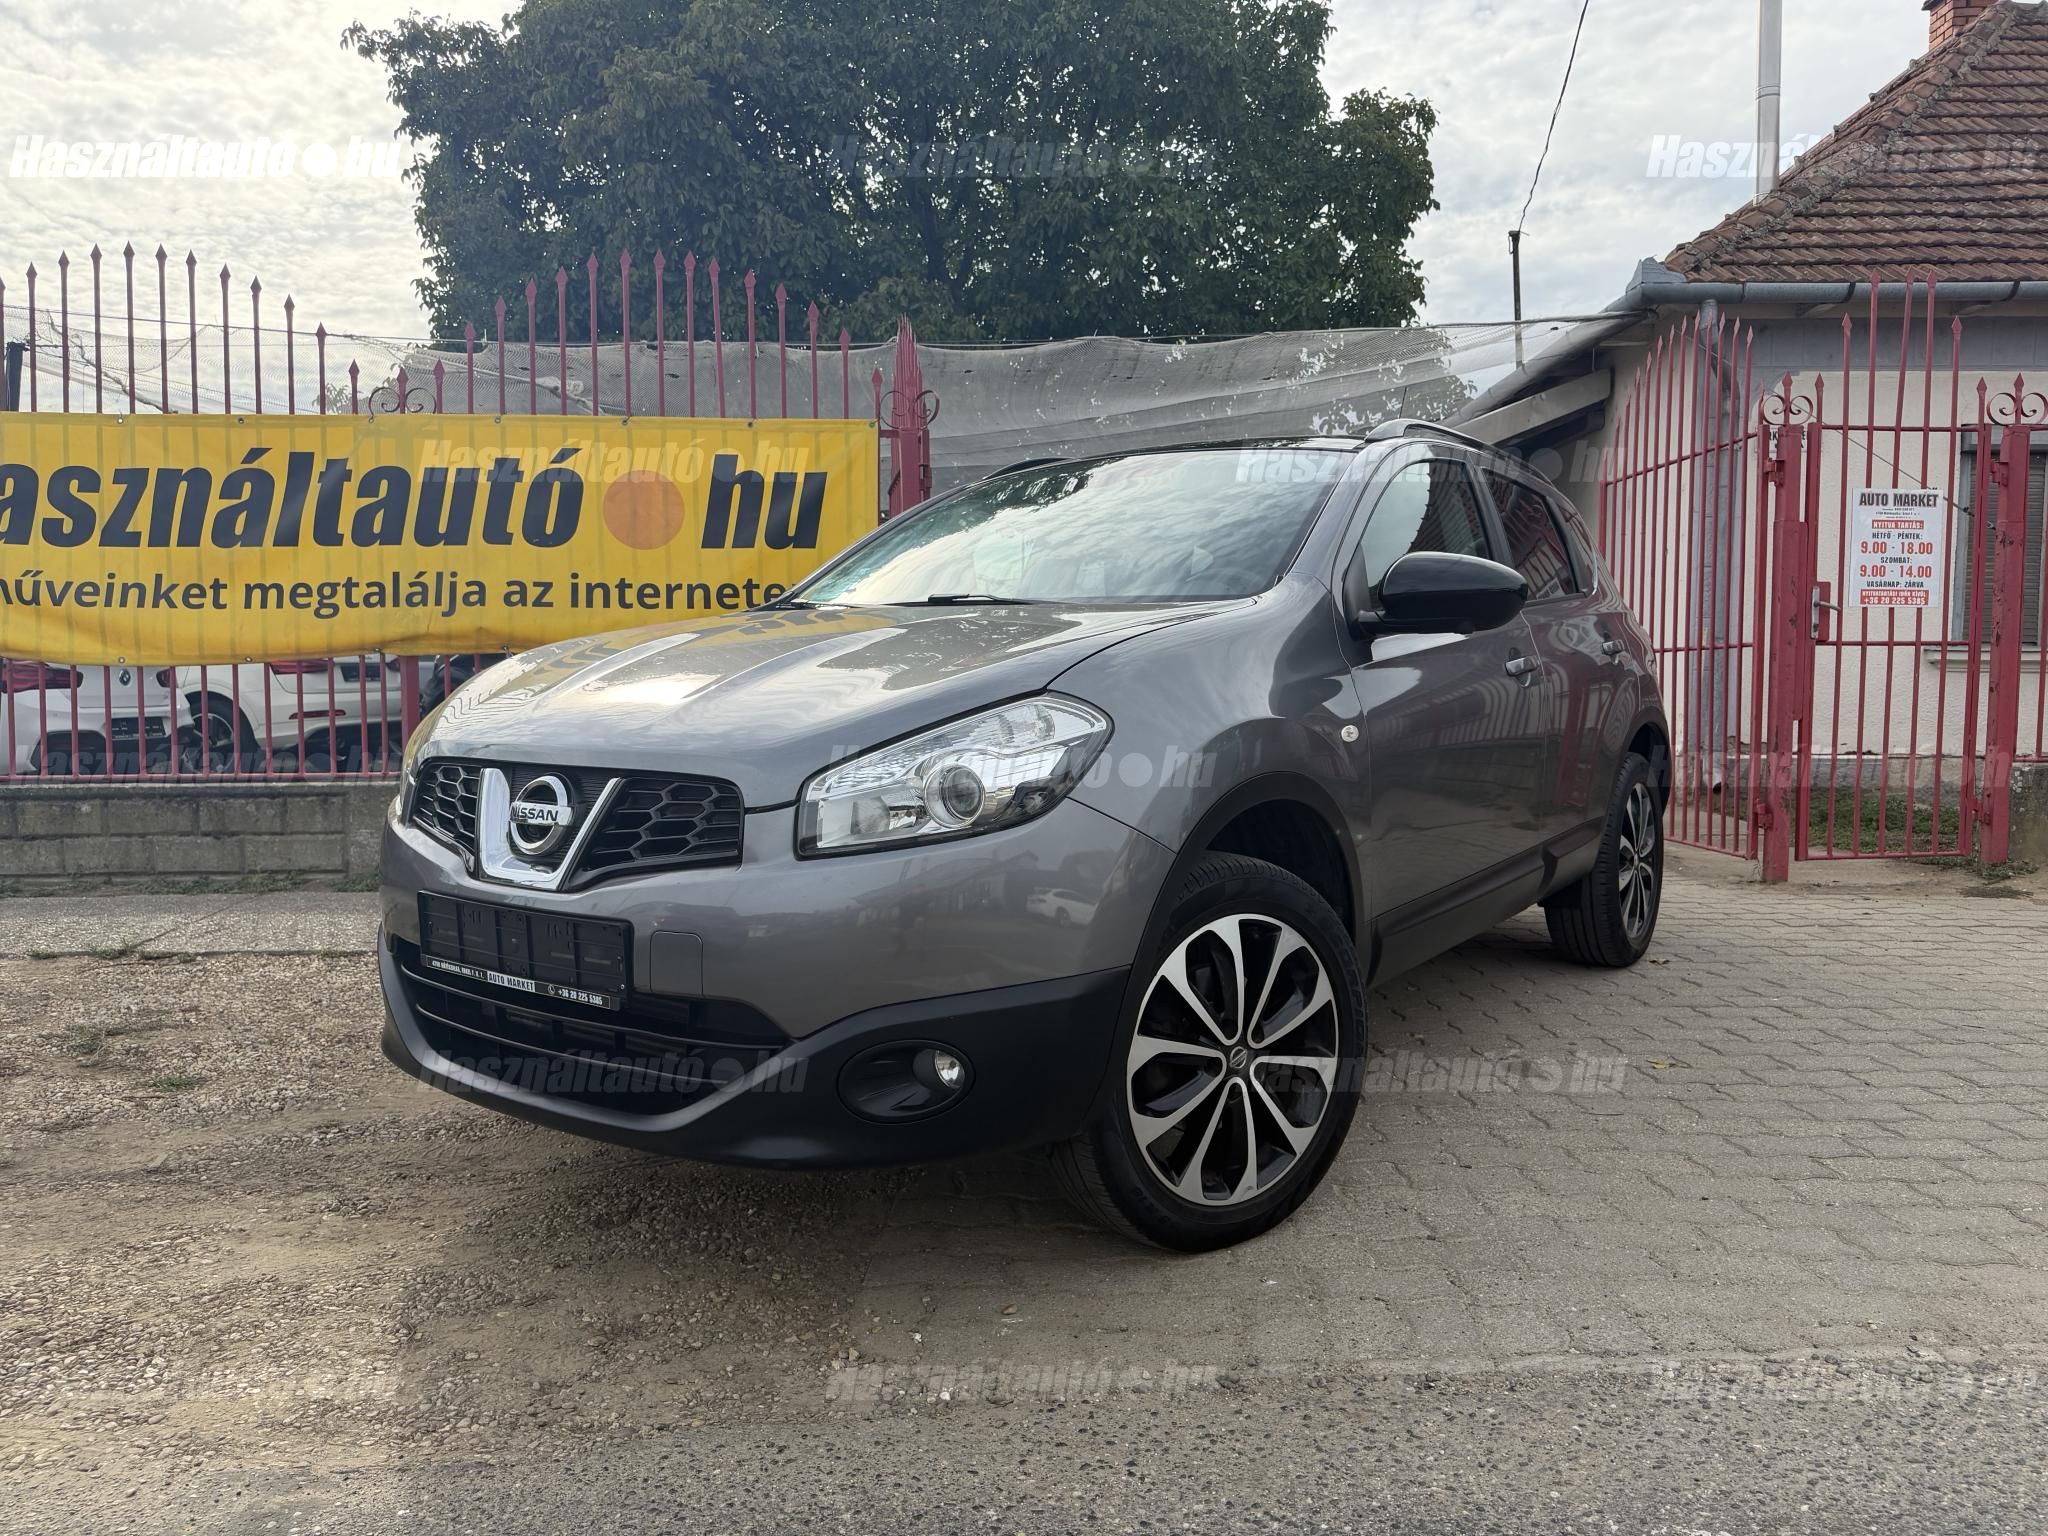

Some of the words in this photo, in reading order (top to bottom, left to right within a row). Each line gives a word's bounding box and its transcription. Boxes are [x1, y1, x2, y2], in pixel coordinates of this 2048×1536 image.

[1859, 493, 1889, 507] AUTO
[1893, 494, 1938, 508] MARKET
[1861, 541, 1887, 554] 9.00
[1900, 542, 1933, 554] 18.00
[1860, 565, 1886, 577] 9.00
[1900, 565, 1932, 578] 14.00
[244, 571, 487, 620] megtalálja
[503, 580, 554, 608] az
[570, 572, 796, 609] internete
[510, 805, 558, 822] NISSAN
[488, 972, 505, 985] AUTO
[507, 976, 534, 991] MARKET
